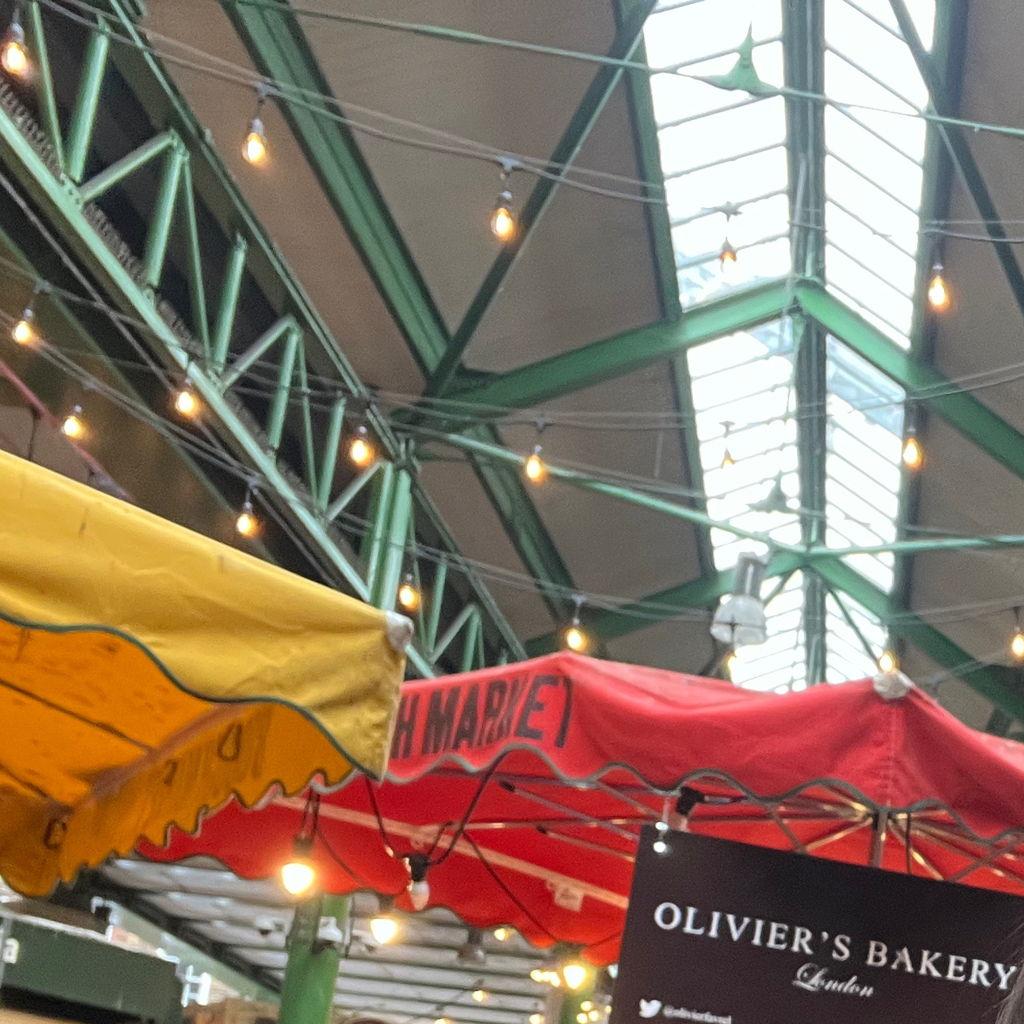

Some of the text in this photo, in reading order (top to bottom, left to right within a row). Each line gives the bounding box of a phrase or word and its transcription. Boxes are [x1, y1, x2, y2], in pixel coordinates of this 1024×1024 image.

[653, 902, 1018, 991] OLIVIER'S BAKERY
[793, 963, 874, 997] London
